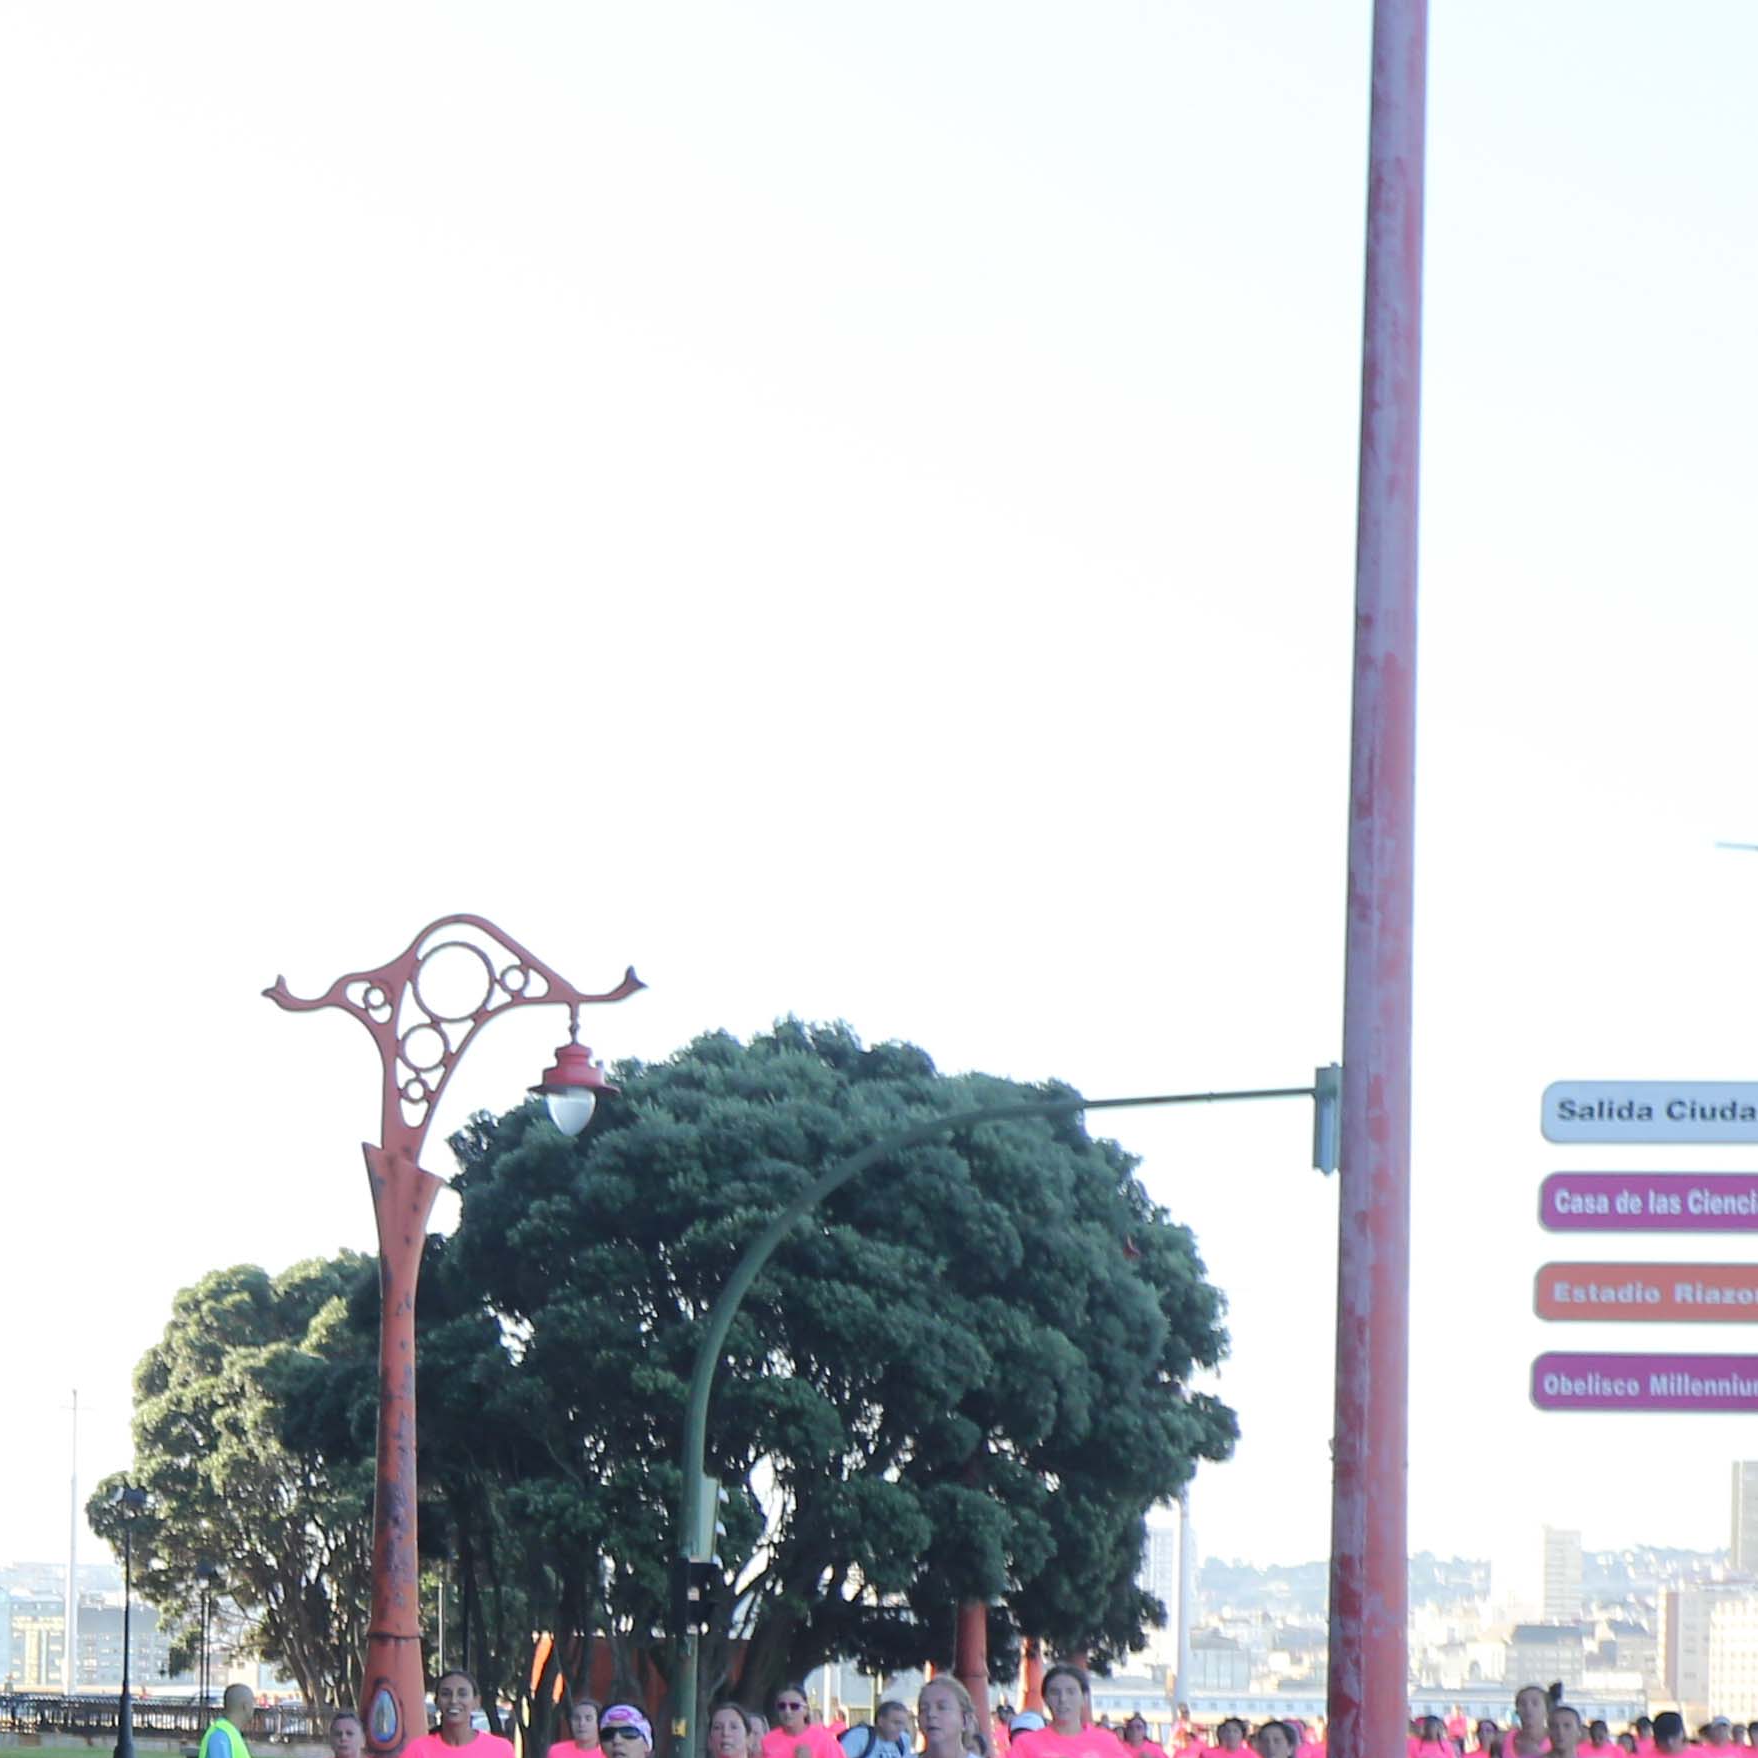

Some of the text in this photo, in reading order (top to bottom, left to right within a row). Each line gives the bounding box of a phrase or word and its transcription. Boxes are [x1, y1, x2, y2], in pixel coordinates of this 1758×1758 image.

[1556, 1099, 1757, 1121] Salida Ciuda
[1554, 1188, 1610, 1215] Casa
[1615, 1188, 1643, 1215] de
[1649, 1188, 1683, 1215] las
[1553, 1281, 1758, 1305] Estadio Riazo
[1542, 1373, 1641, 1397] Obelisco
